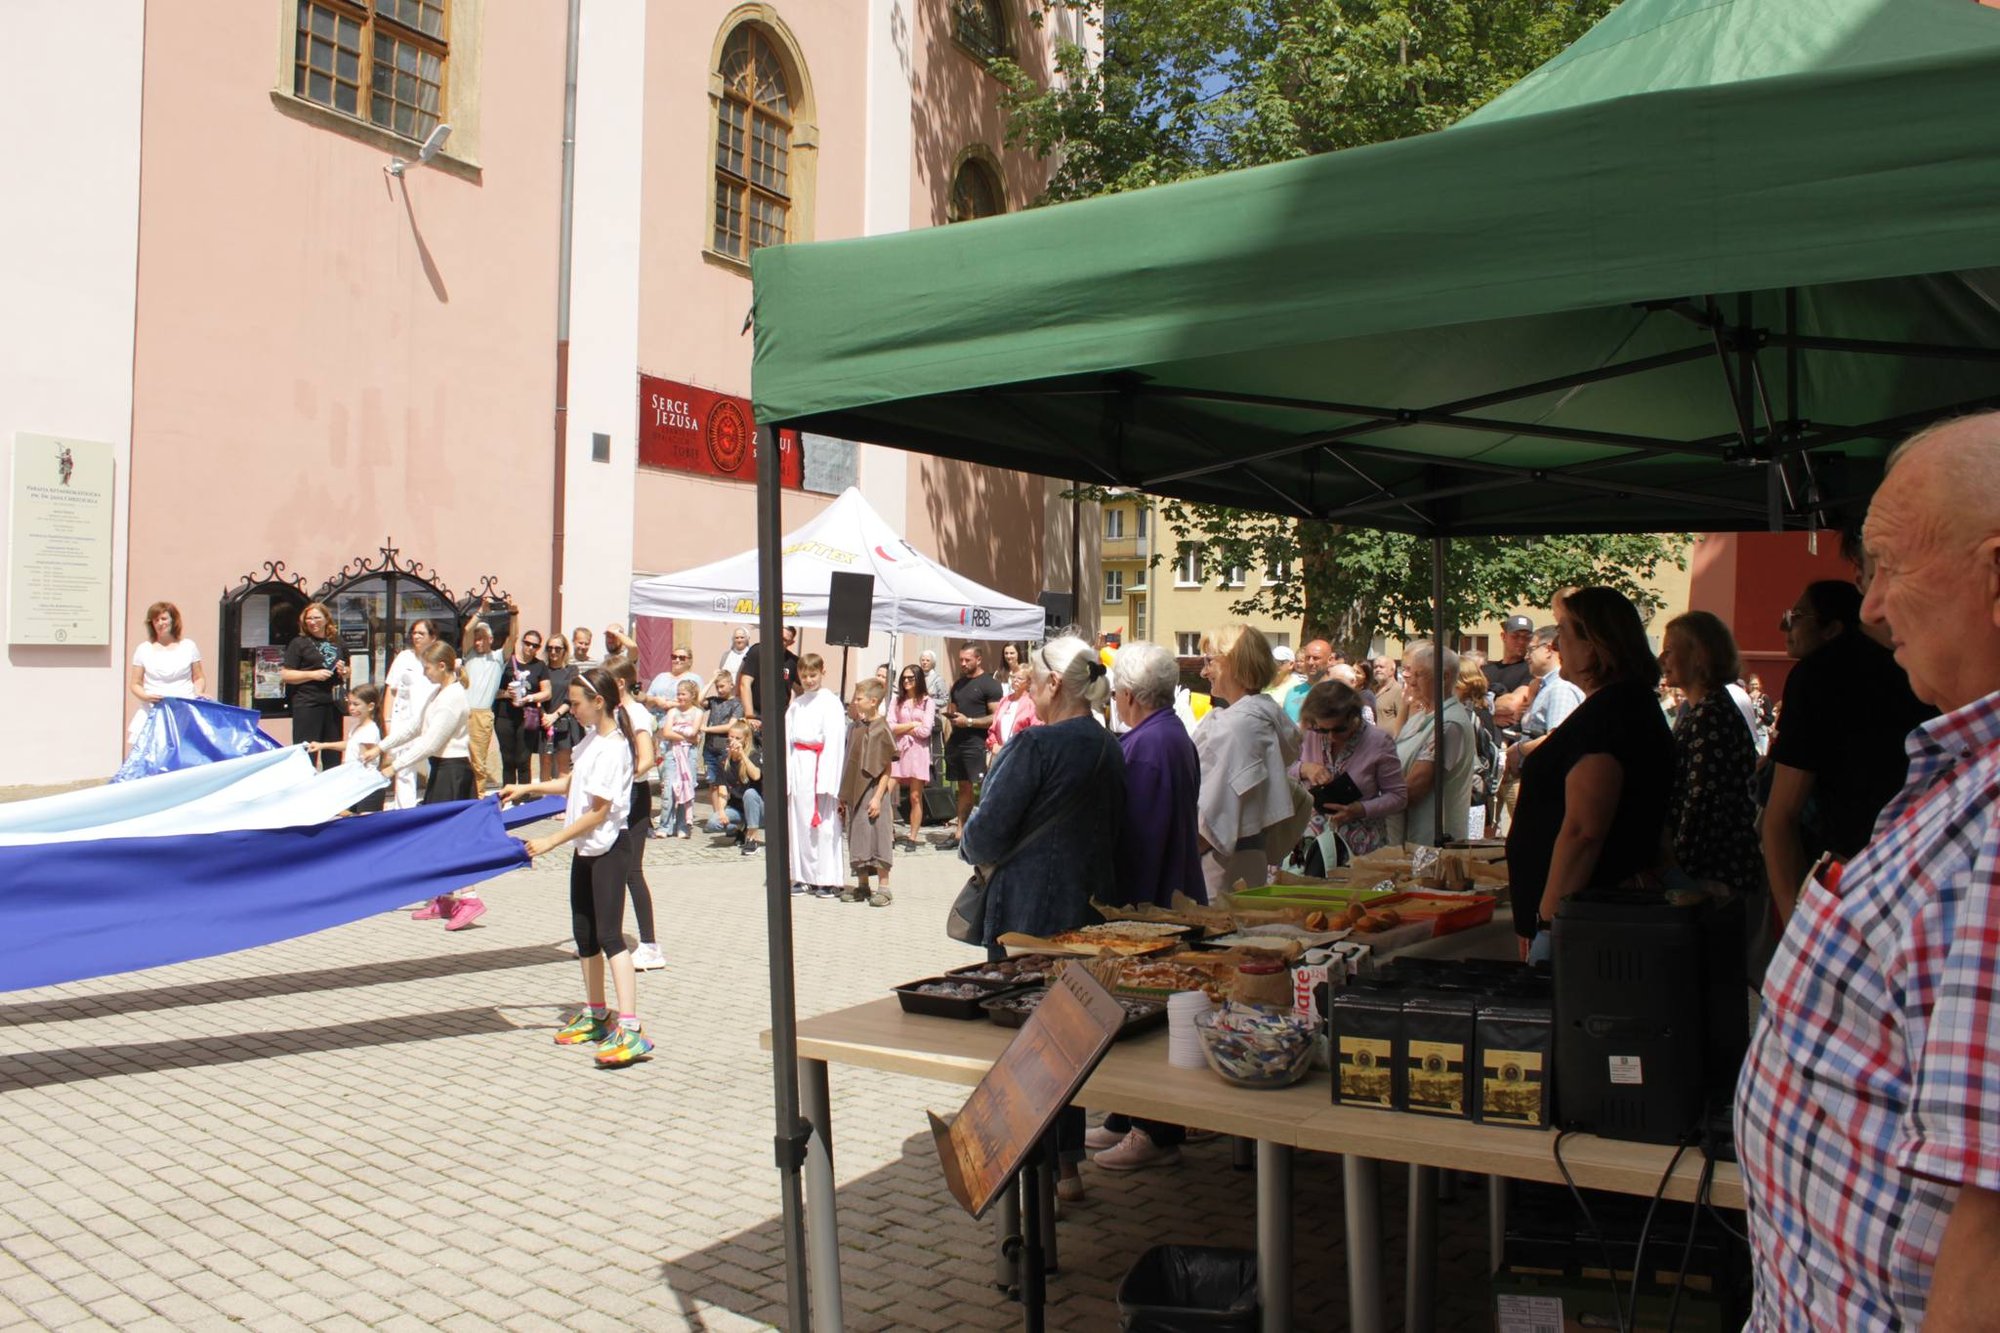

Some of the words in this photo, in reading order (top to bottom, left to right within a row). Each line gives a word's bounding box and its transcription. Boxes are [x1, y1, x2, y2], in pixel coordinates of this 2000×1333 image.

[652, 393, 689, 415] SERCE
[656, 408, 698, 431] JEZUSA
[972, 608, 991, 627] RBB
